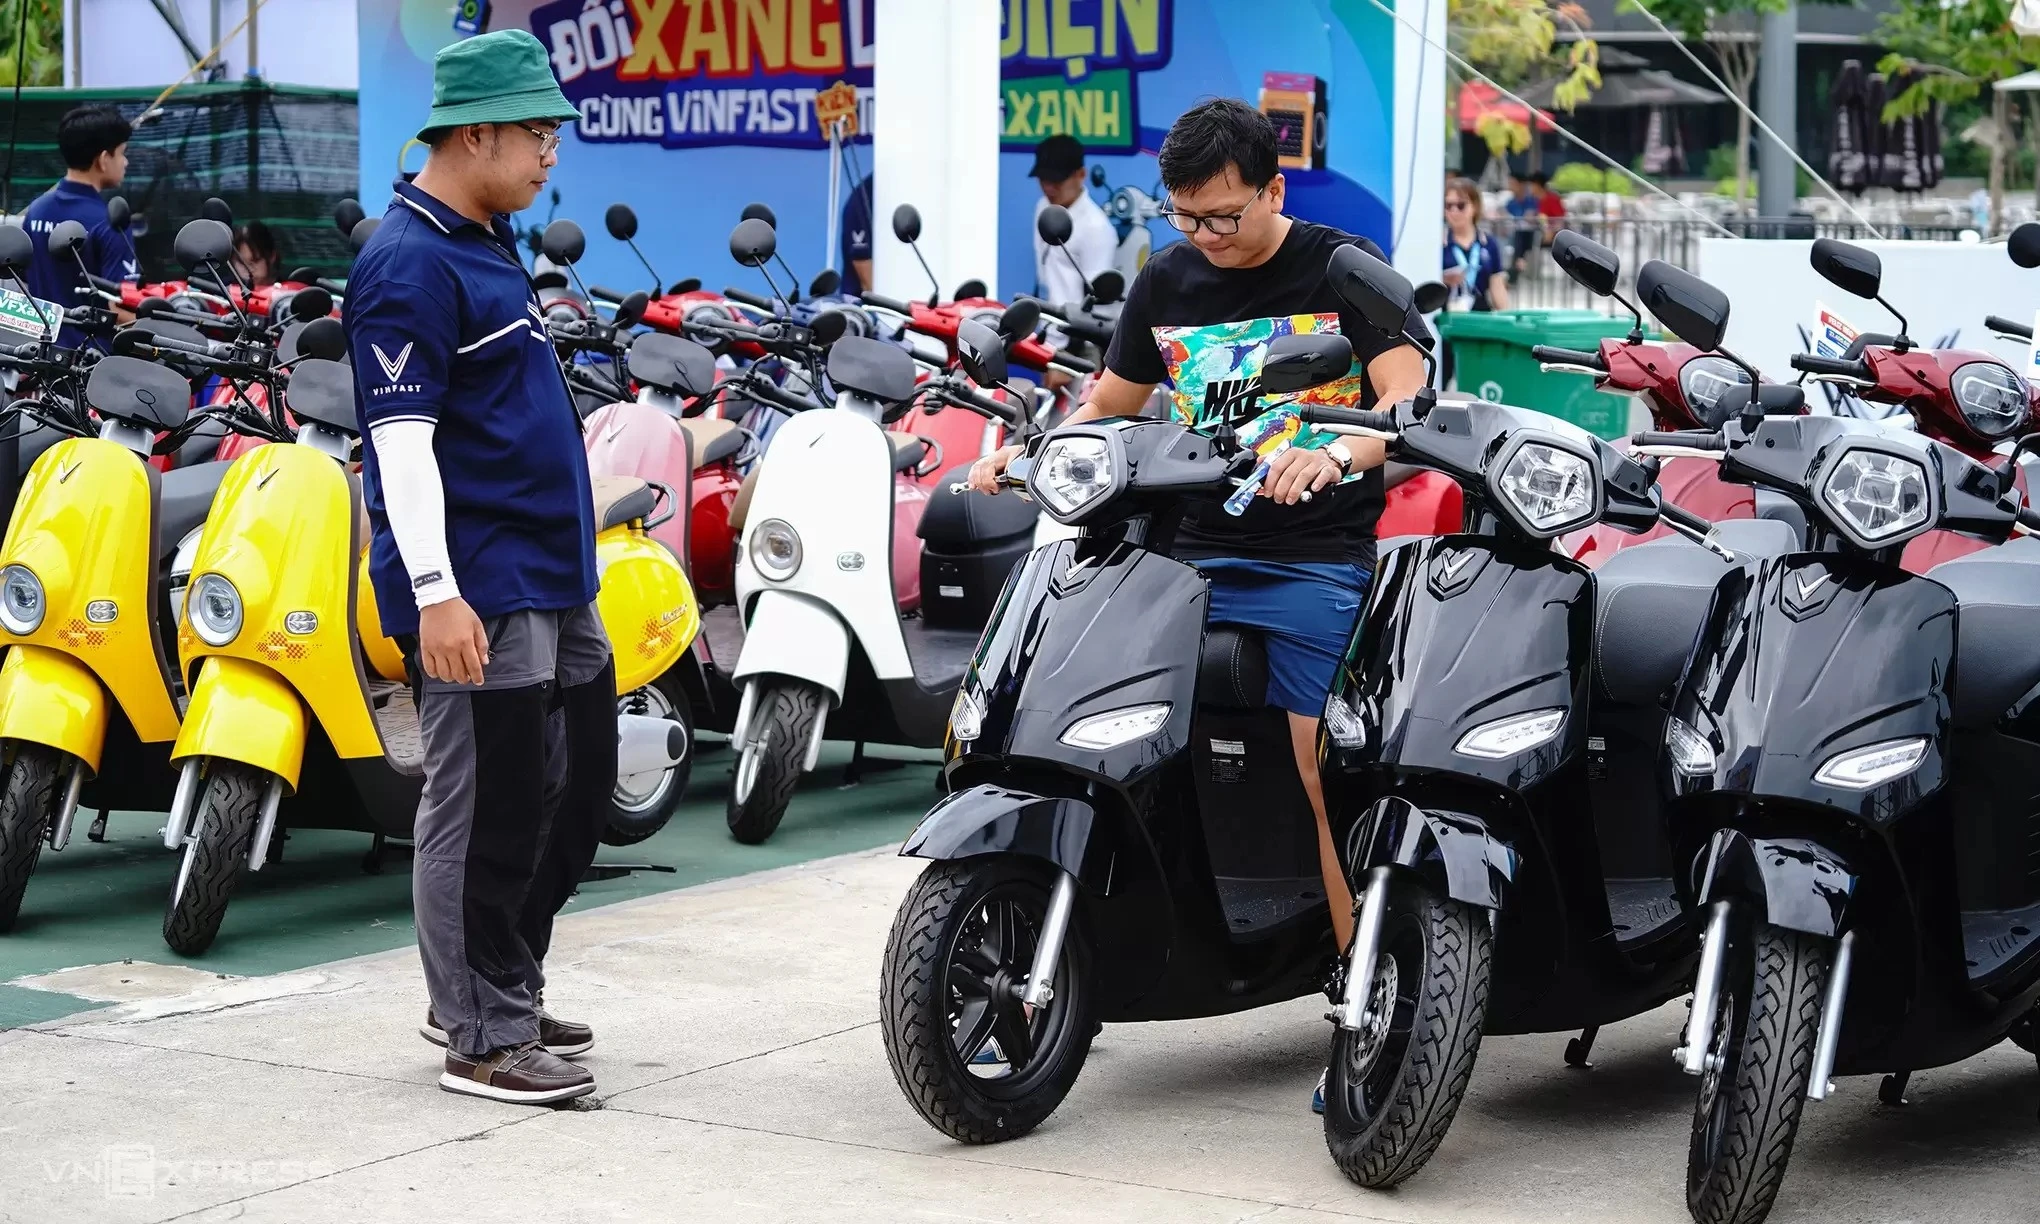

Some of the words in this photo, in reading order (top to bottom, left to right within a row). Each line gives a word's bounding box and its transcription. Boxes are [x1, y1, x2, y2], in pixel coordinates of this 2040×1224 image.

[579, 93, 665, 137] CÙNG
[1006, 89, 1120, 137] XANH
[373, 384, 421, 396] VINFAST
